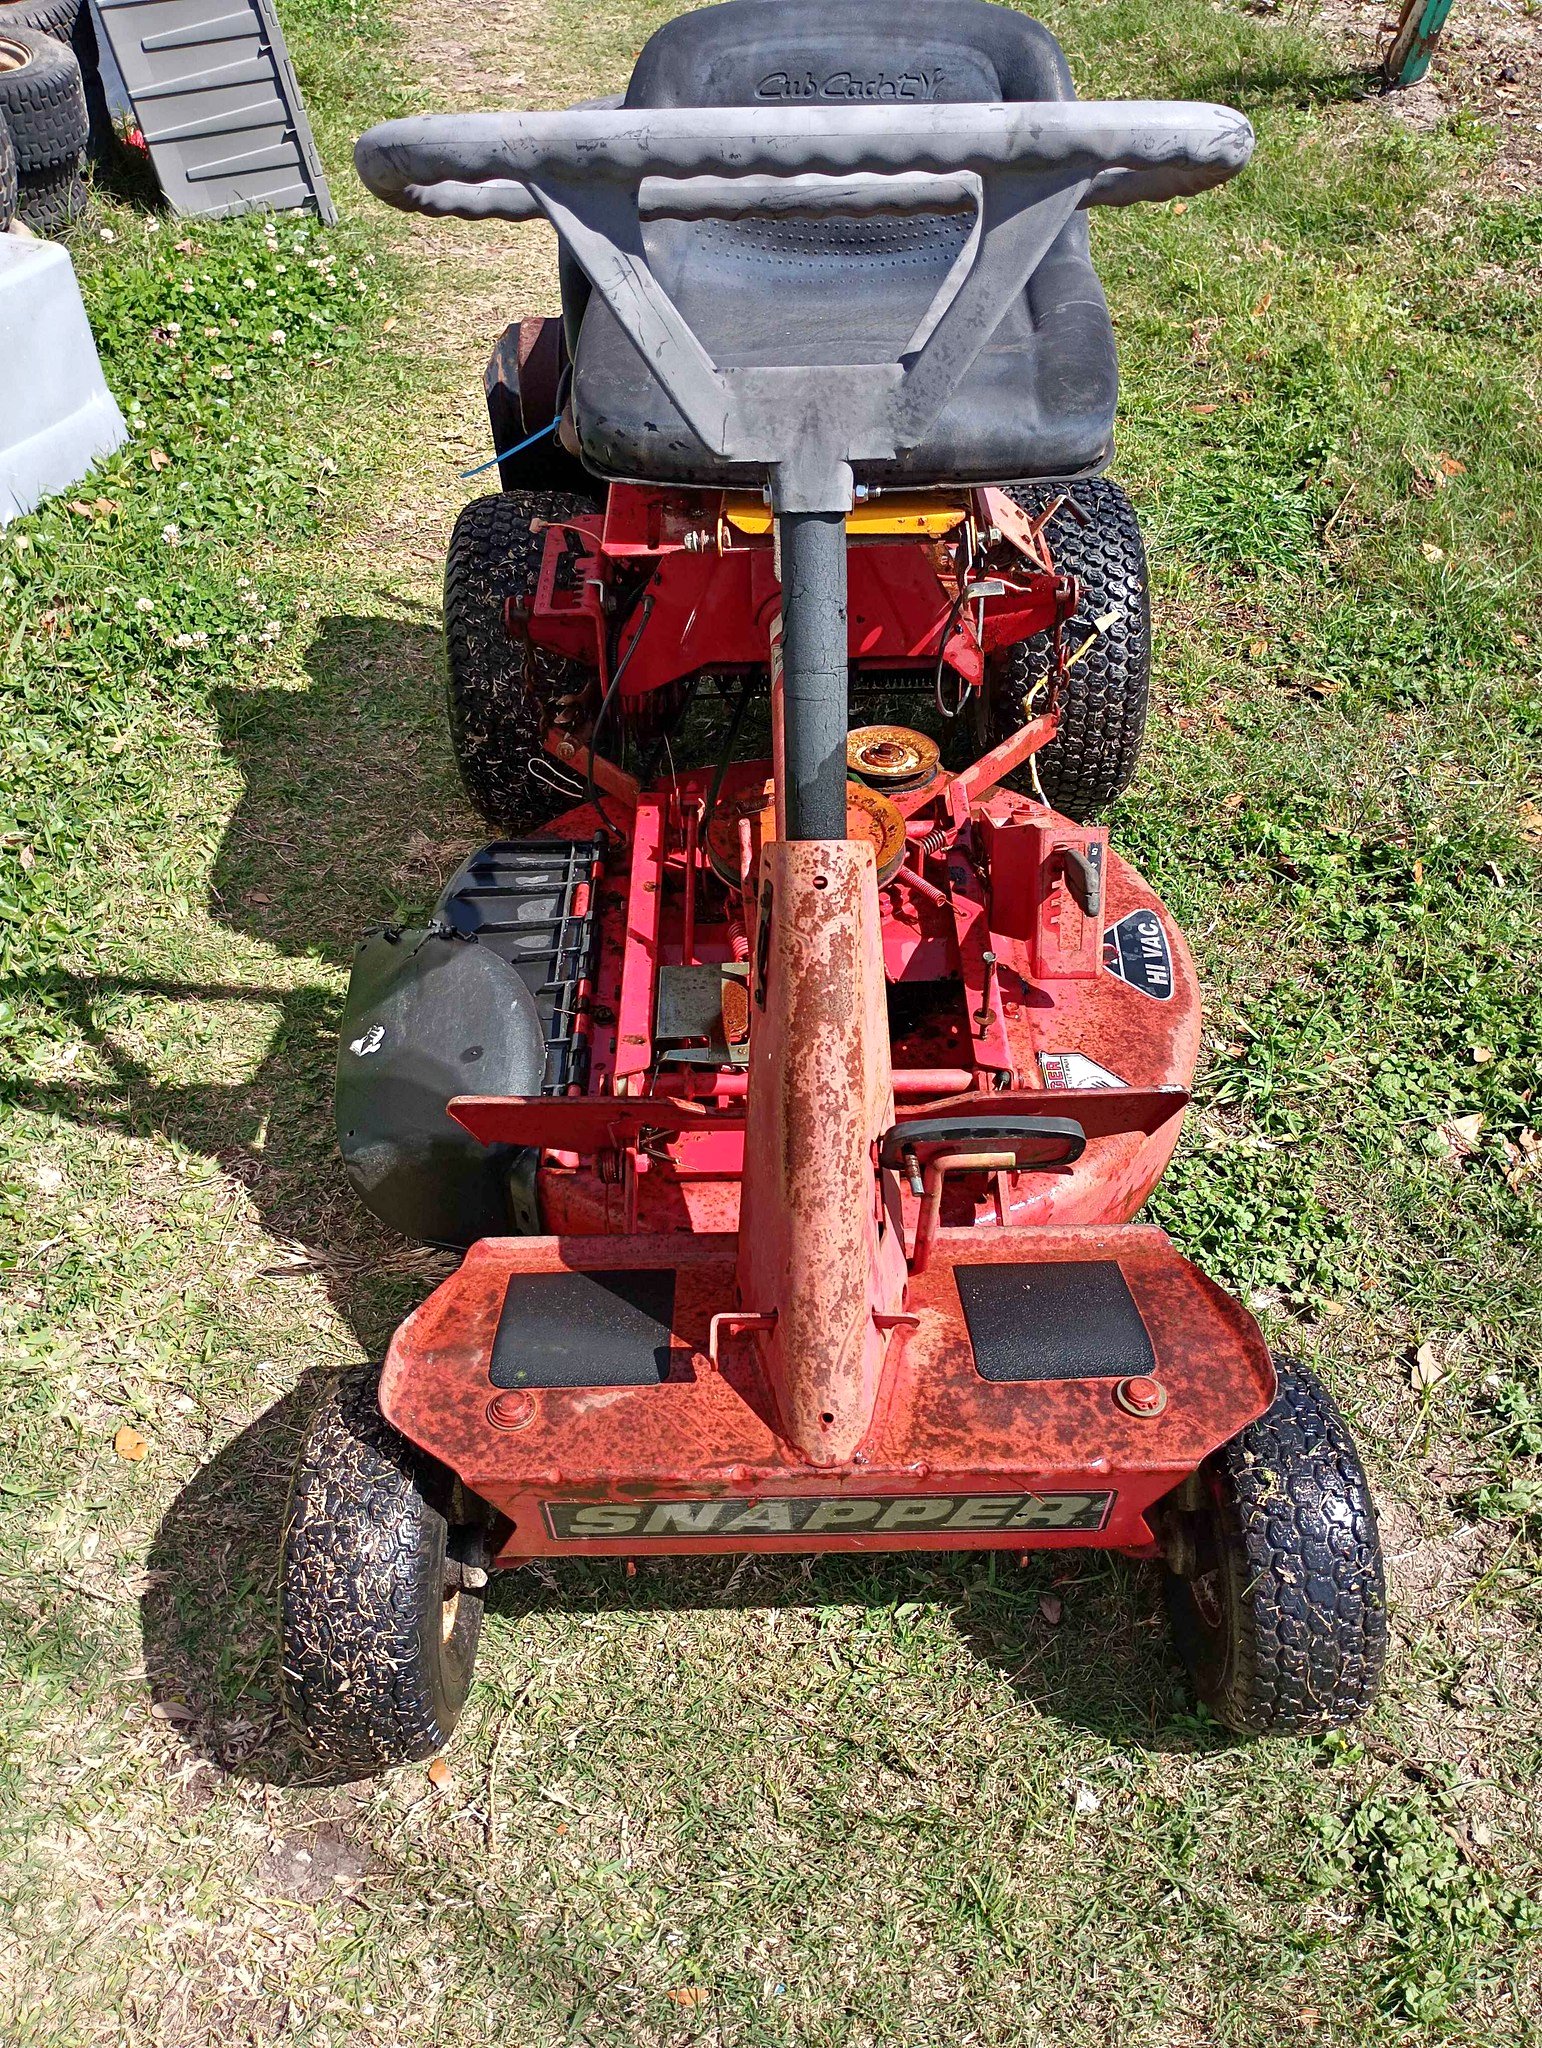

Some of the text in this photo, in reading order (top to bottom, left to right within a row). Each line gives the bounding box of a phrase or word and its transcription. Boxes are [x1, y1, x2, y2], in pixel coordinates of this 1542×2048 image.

[754, 72, 919, 99] Cub Cadet
[1145, 963, 1168, 985] HI
[1046, 1061, 1065, 1088] GER
[570, 1496, 1088, 1534] SNAPPER
